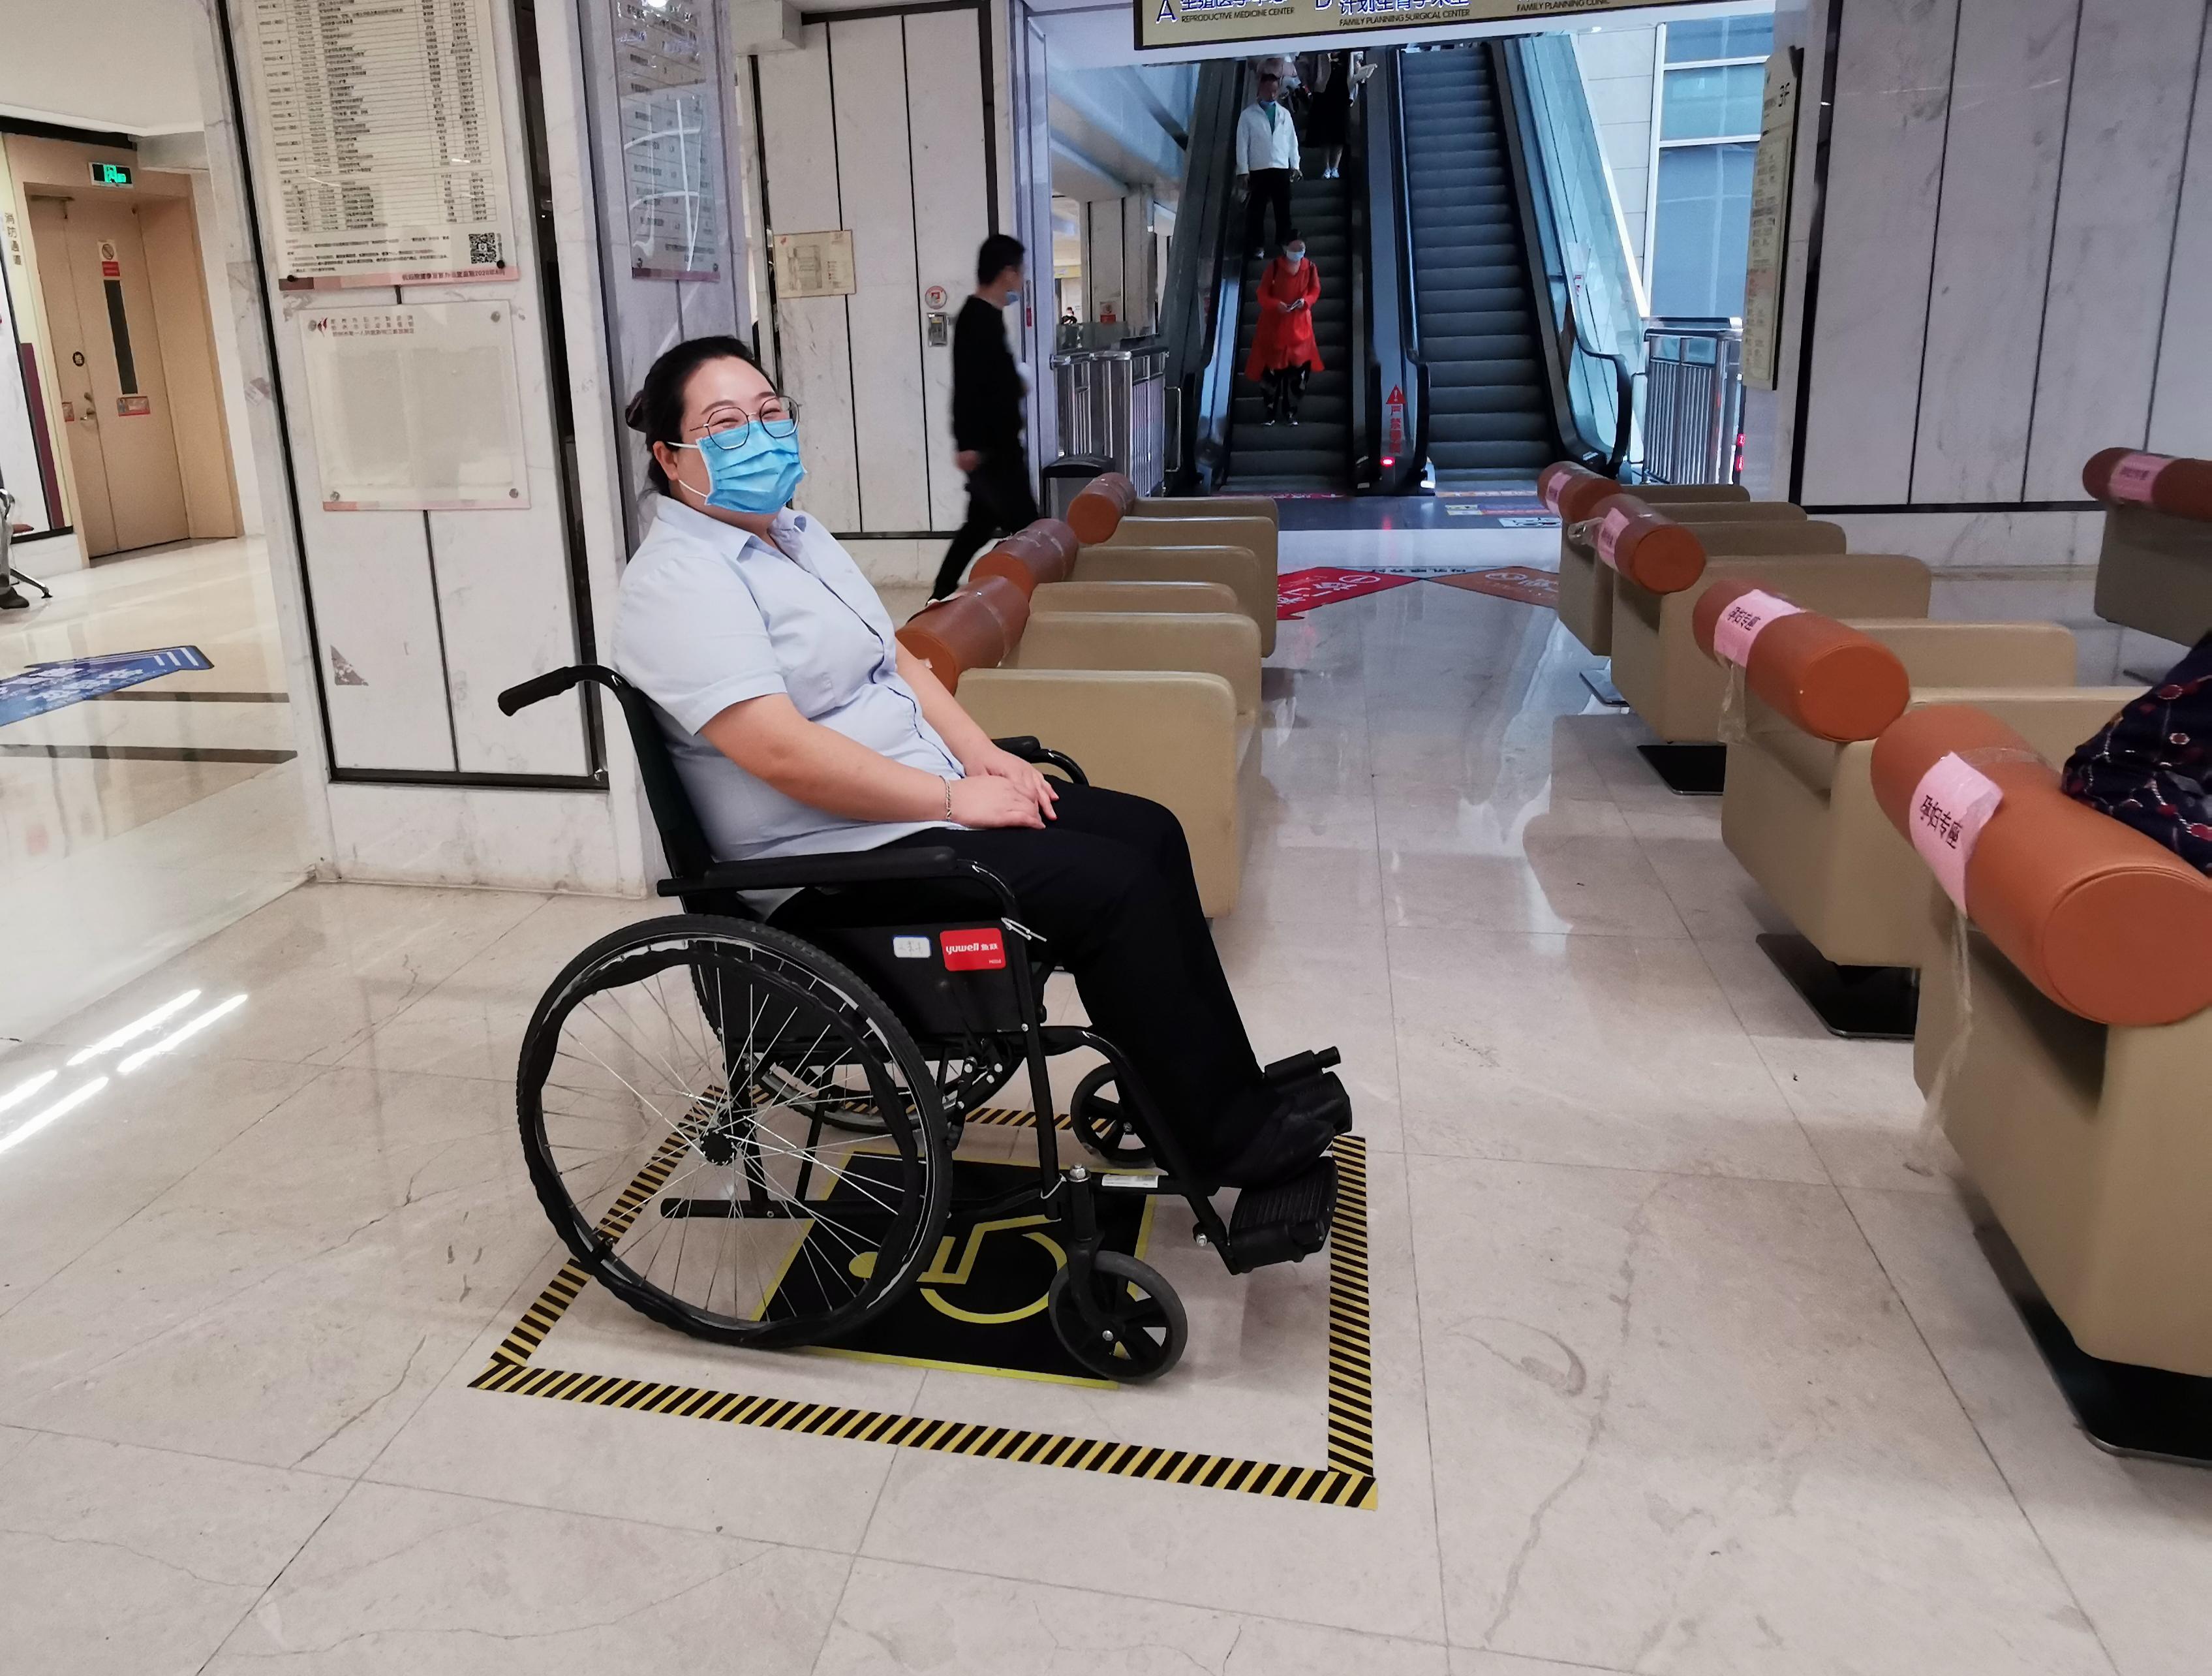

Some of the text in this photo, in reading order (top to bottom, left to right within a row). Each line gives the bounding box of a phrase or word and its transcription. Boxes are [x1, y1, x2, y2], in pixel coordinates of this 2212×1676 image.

[1182, 7, 1295, 22] REPRODUCTIVE MEDICINE CENTER
[1340, 8, 1470, 26] FAMILY PLANNING SURGICAL CENTER
[945, 942, 979, 955] yuwell
